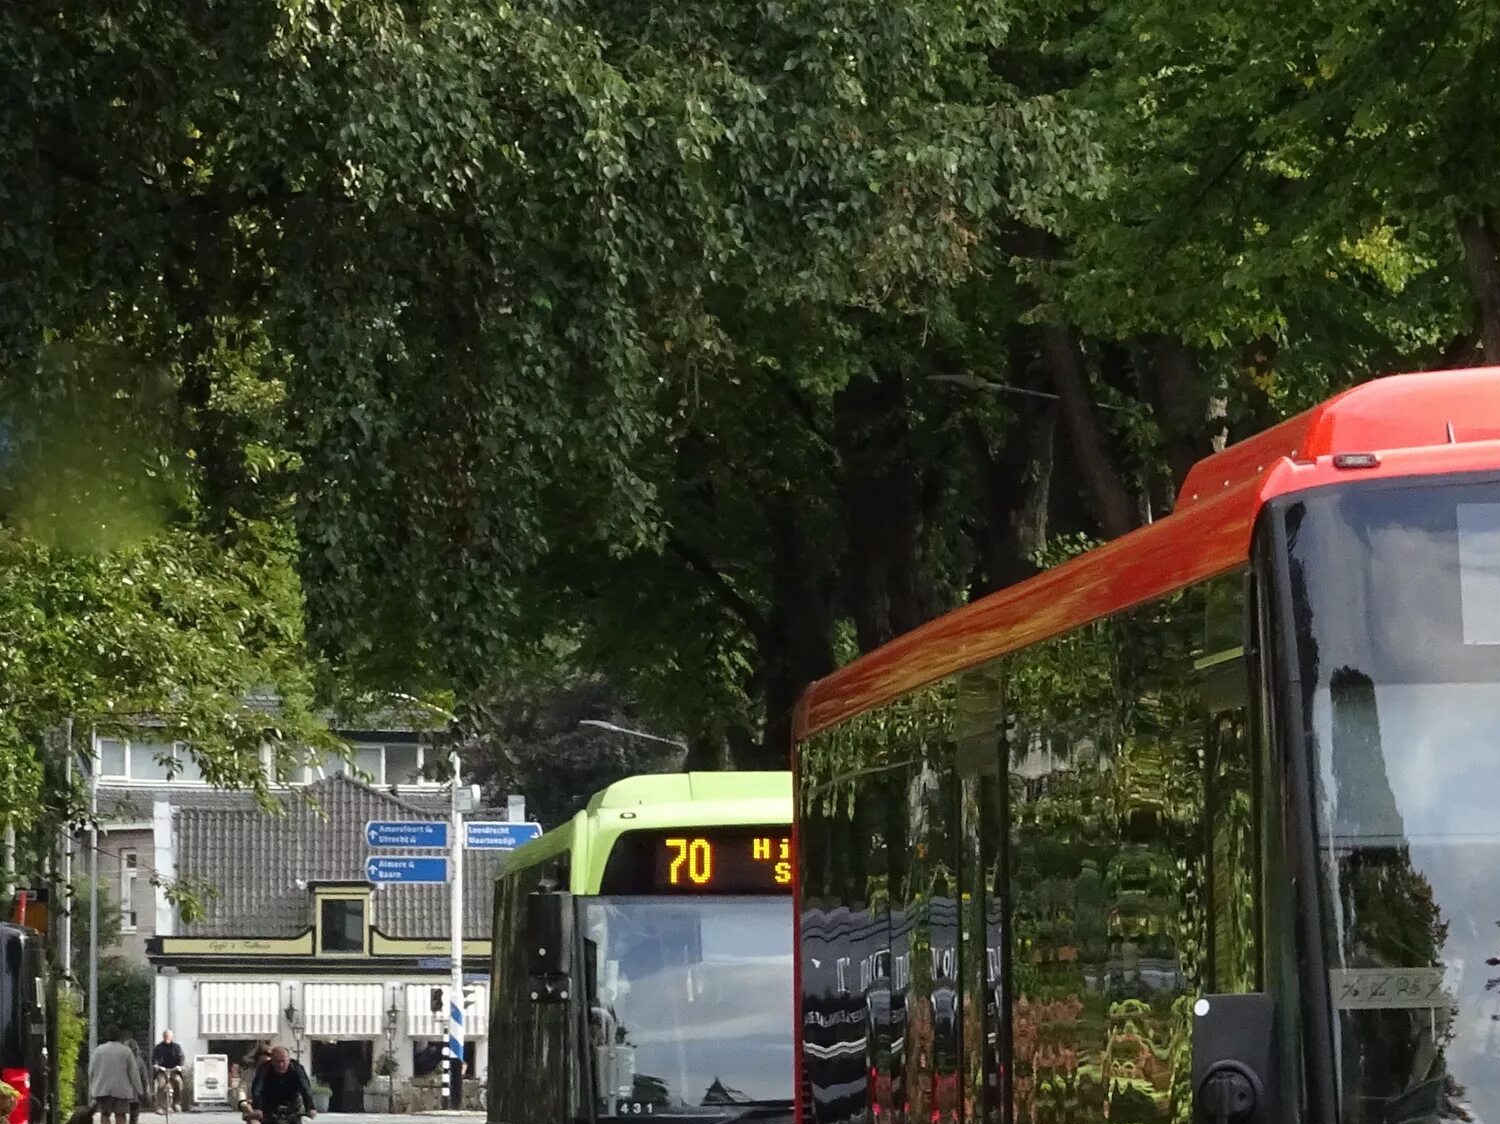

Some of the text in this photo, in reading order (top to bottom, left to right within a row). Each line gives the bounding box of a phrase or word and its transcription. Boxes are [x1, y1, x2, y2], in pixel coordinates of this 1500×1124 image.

[379, 835, 409, 844] Utrecht
[665, 838, 789, 884] 70 Hi
[774, 862, 792, 883] S
[620, 1103, 653, 1114] 431
